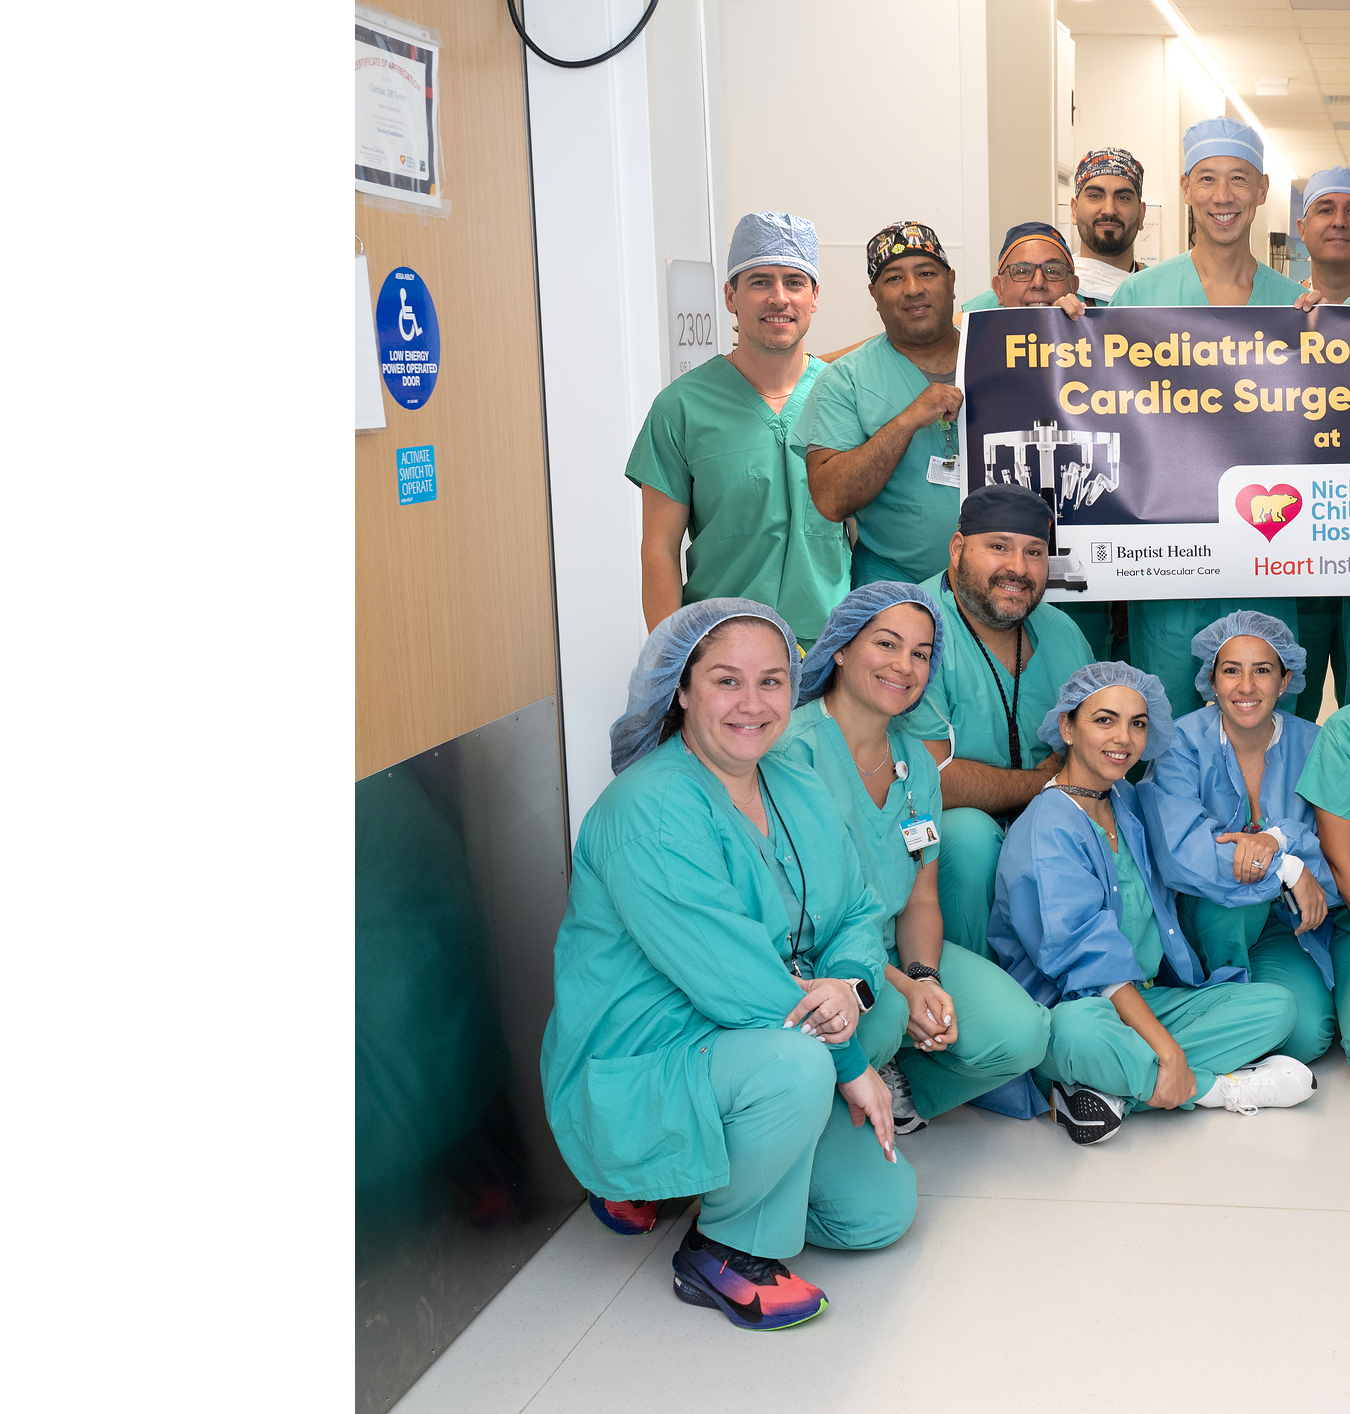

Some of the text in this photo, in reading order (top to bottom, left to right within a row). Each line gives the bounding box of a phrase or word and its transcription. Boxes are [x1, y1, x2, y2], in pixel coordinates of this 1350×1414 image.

[355, 57, 381, 71] ERTIFICATE
[677, 312, 713, 346] 2302
[389, 350, 429, 361] LOW ENERGY
[1005, 332, 1092, 368] First
[1104, 330, 1289, 368] Pediatric
[382, 363, 438, 374] POWER OPERATED
[680, 361, 687, 372] OR
[402, 376, 420, 387] DOOR
[1059, 380, 1223, 415] Cardiac
[1313, 428, 1341, 448] at
[401, 449, 430, 465] ACTIVATE
[399, 464, 434, 481] SWITCH TO
[402, 479, 434, 496] OPERATE
[1116, 544, 1212, 561] Baptist Health
[1116, 566, 1221, 577] Heart & Vascular Care
[1254, 556, 1315, 576] Heart
